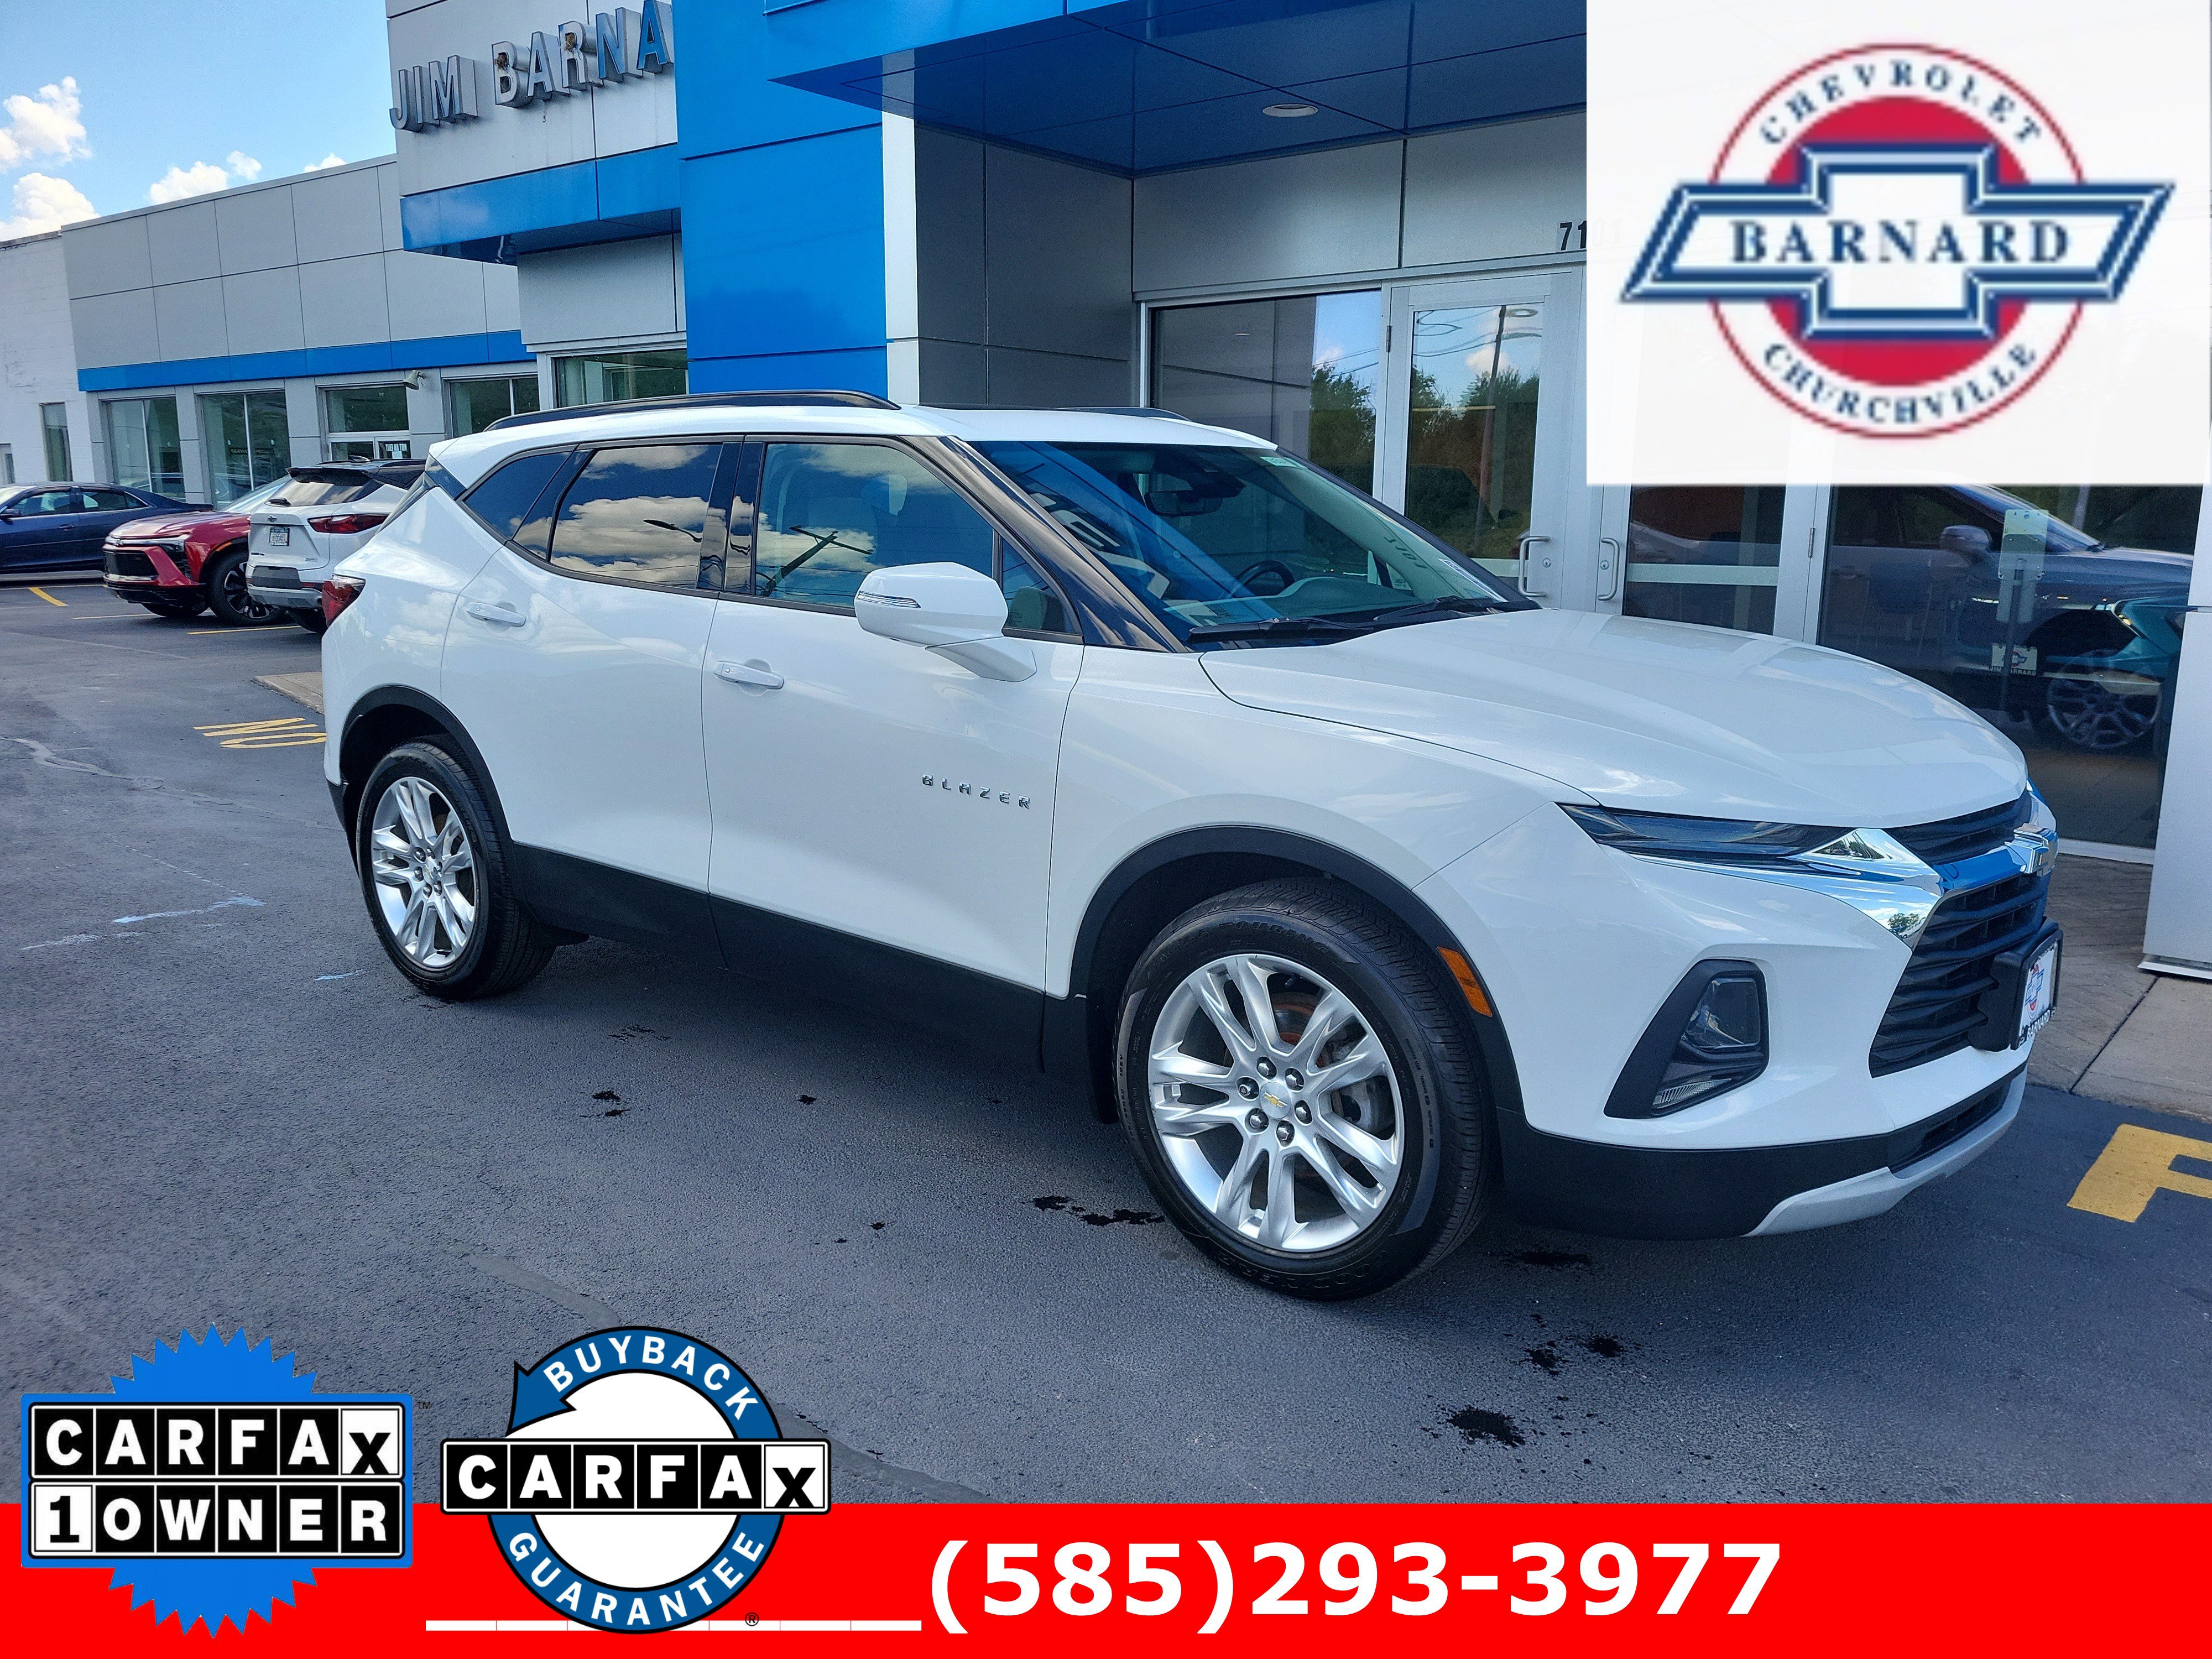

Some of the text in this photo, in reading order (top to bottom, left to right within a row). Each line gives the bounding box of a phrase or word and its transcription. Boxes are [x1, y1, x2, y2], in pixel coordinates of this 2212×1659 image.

[389, 55, 478, 132] JIM
[921, 773, 1031, 810] BLAZER
[1218, 920, 1330, 954] TOURING
